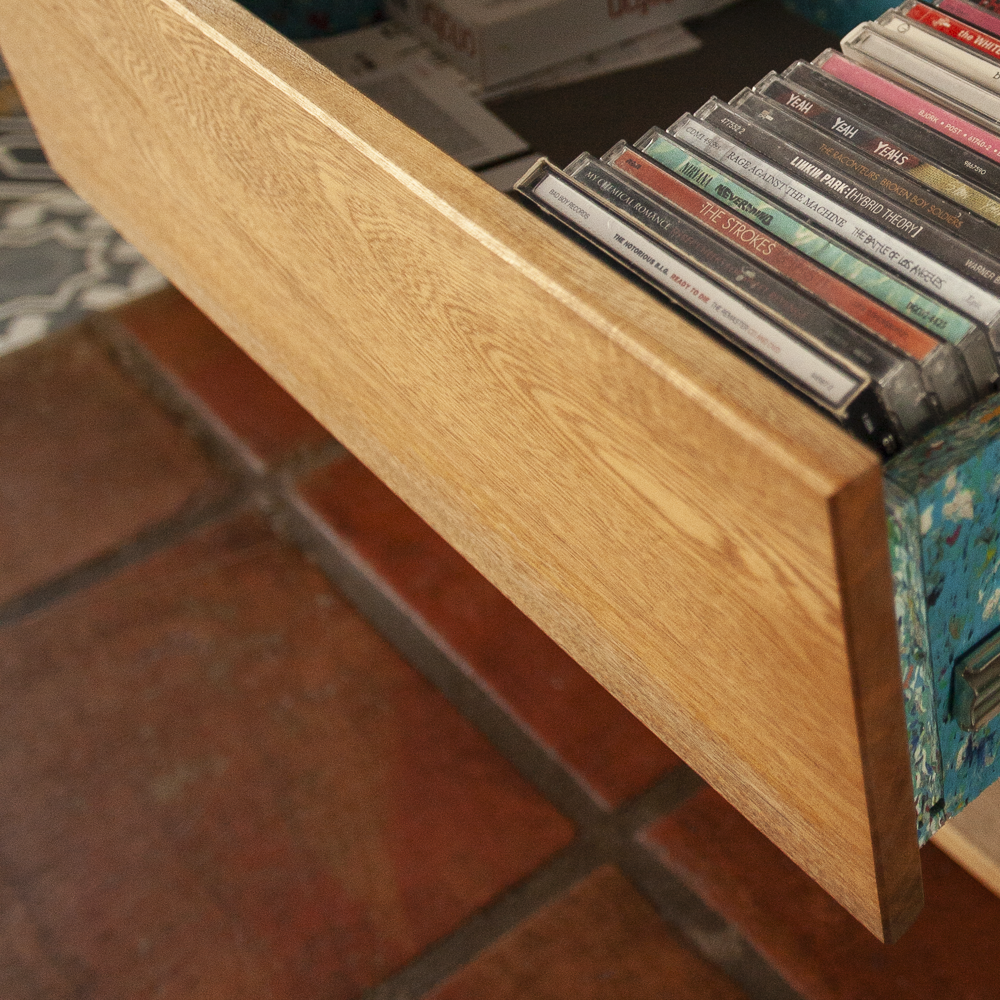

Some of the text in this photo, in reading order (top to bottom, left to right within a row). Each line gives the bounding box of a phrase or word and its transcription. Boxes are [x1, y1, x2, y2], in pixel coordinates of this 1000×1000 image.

[957, 28, 975, 41] the
[784, 93, 910, 166] YEAH YEAH YEAHS
[943, 123, 962, 135] POST
[966, 134, 992, 151] 61740-2
[678, 161, 775, 225] NIRVANA NEVERMIND
[818, 143, 964, 228] THE RACONTEURS BROKEN BOY SOLDIERS
[962, 160, 987, 175] 9867590
[547, 188, 590, 219] BAD BOY RECORDS
[583, 170, 672, 229] MY CHEMICAL ROMANCE
[726, 151, 751, 169] RAGE
[748, 165, 787, 191] AGAINST
[785, 187, 805, 202] THE
[803, 198, 847, 227] MACHINE
[850, 226, 866, 239] THE
[862, 235, 890, 254] BATTLE
[896, 256, 913, 268] LOS
[908, 263, 946, 289] ANGELES
[879, 208, 923, 238] THEORY]
[697, 202, 726, 223] THE
[719, 217, 777, 255] STROKES
[612, 233, 625, 243] THE
[622, 240, 656, 264] NOTORIOUS
[653, 261, 670, 275] B.I.G.
[668, 273, 691, 290] READY
[688, 287, 700, 296] TO
[697, 293, 710, 303] DIE
[963, 259, 996, 280] WARNER
